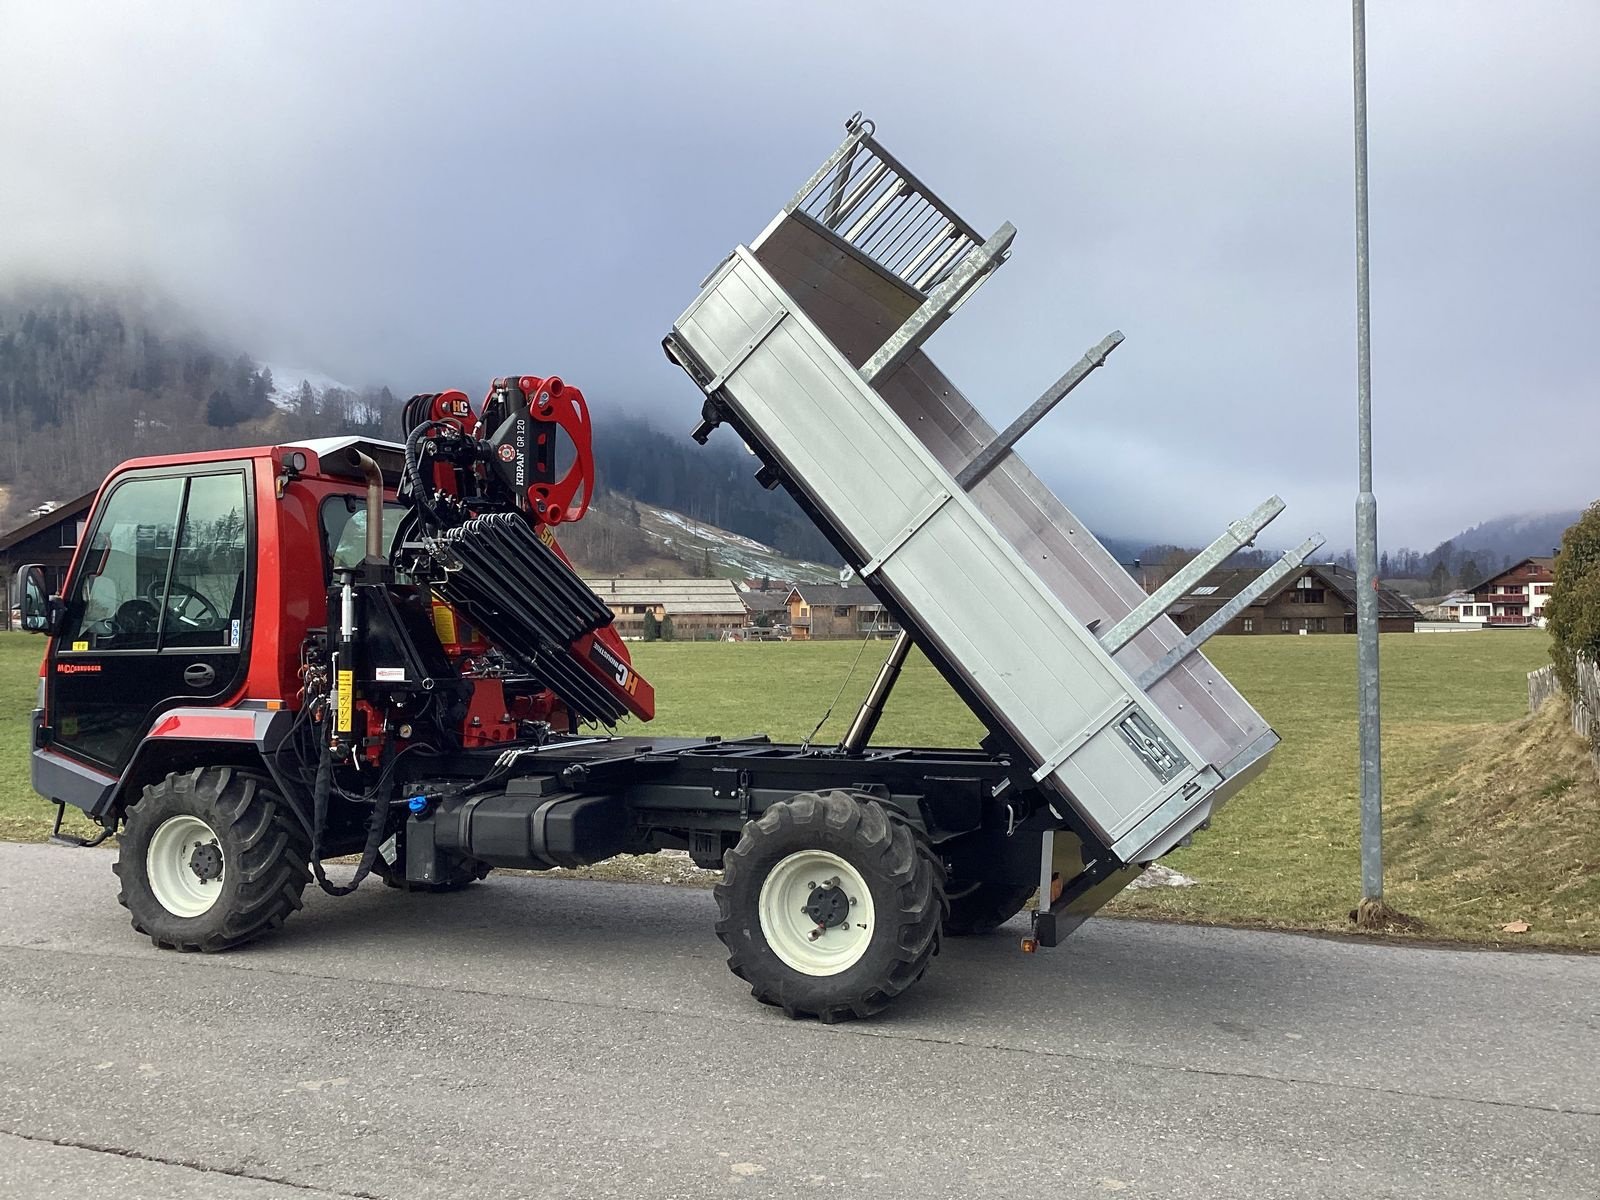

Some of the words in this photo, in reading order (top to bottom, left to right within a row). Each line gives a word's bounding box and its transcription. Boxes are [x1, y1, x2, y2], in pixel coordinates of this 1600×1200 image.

[452, 400, 468, 413] HC
[516, 419, 525, 435] 120
[516, 436, 525, 448] GR
[516, 452, 525, 486] KRPAN
[593, 641, 619, 669] INDUSTRIE
[615, 664, 639, 696] HC
